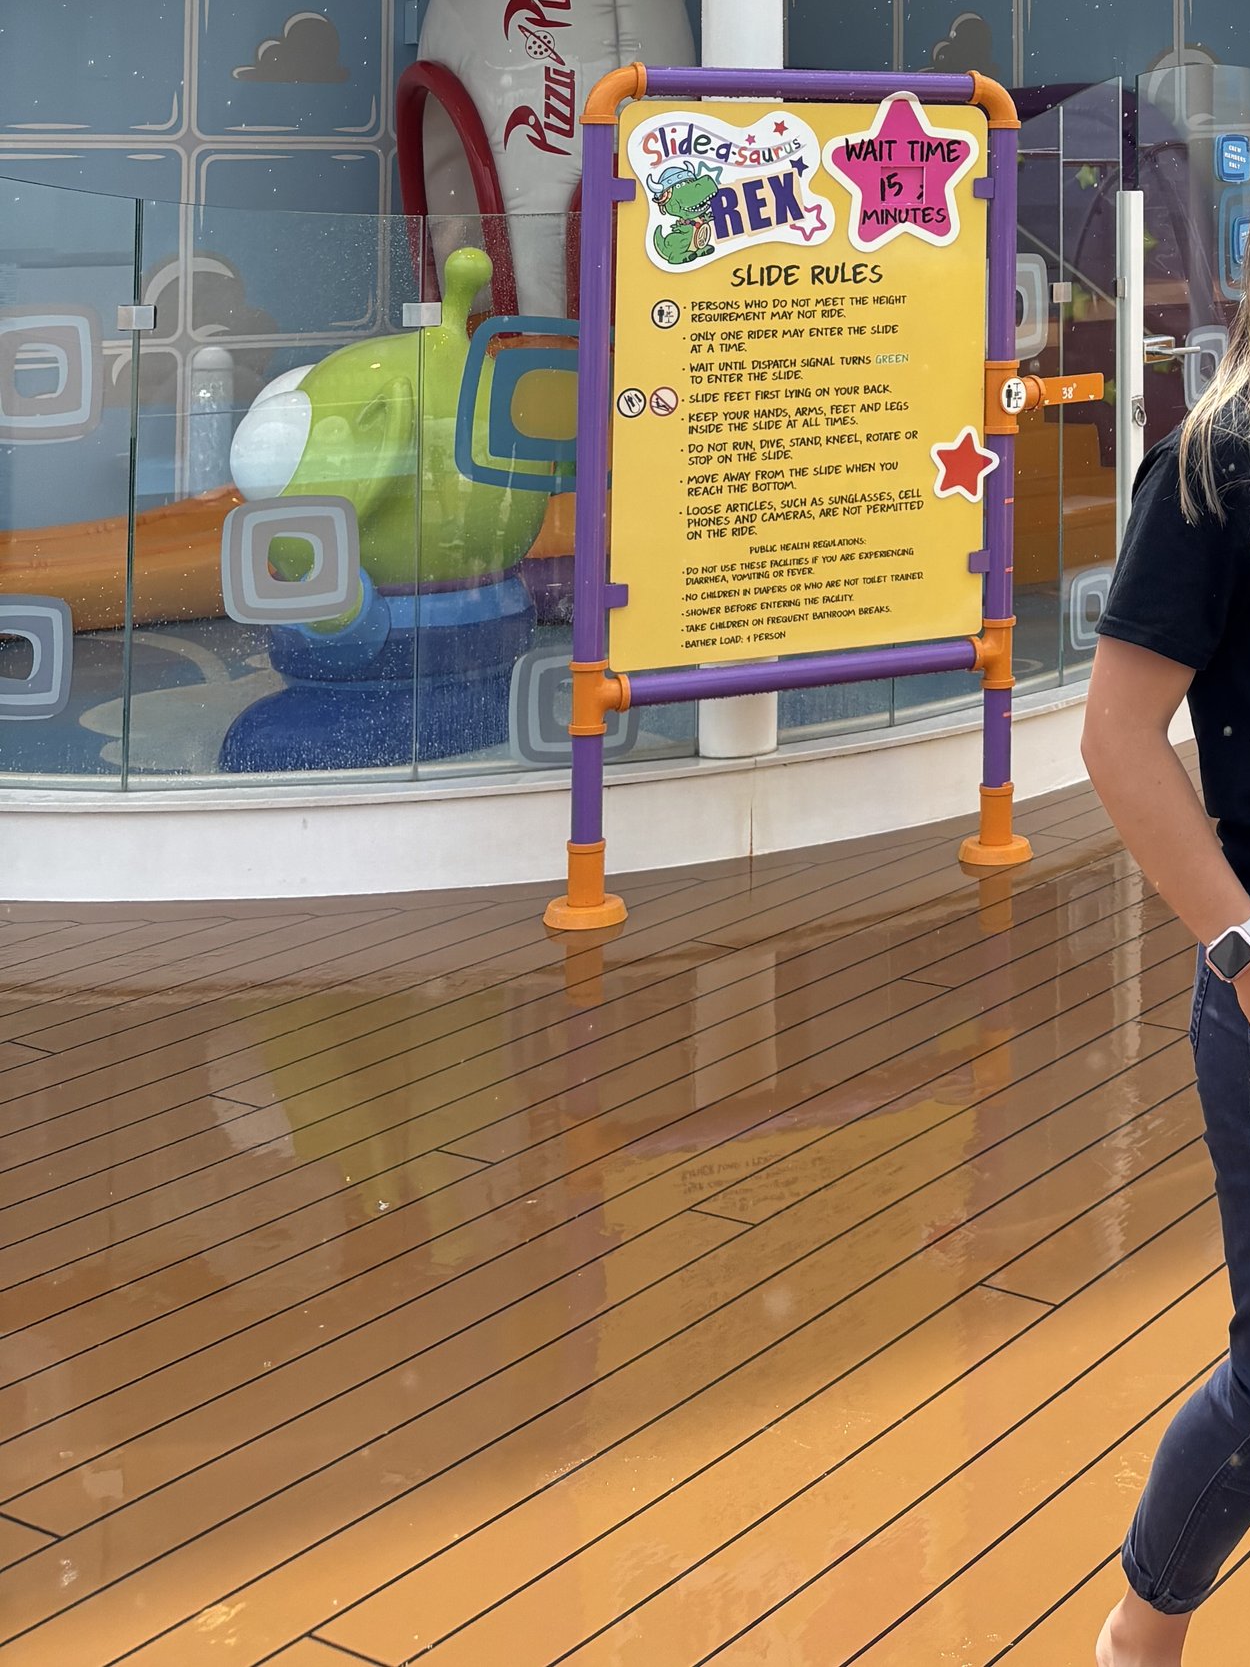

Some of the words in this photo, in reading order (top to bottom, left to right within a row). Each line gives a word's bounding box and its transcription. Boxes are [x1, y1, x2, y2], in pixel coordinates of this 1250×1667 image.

[504, 66, 575, 155] Pizza
[845, 138, 893, 163] WAIT
[909, 139, 961, 163] TIME
[880, 172, 903, 202] 15
[710, 171, 804, 240] REX
[862, 206, 946, 225] MINUTES
[731, 264, 799, 287] SLIDE
[811, 263, 883, 284] RULES
[691, 300, 740, 311] PERSONS
[745, 300, 768, 310] WHO
[772, 299, 788, 308] DO
[792, 298, 811, 308] NOT
[815, 297, 845, 307] MEET
[850, 296, 869, 306] THE
[873, 295, 907, 305] HEIGHT
[691, 310, 767, 323] REQUIREMENT
[770, 311, 794, 320] MAY
[798, 310, 817, 319] NOT
[821, 309, 846, 318] RIDE.
[690, 331, 716, 342] ONLY
[721, 330, 743, 340] ONE
[748, 330, 778, 340] RIDER
[782, 329, 805, 338] MAY
[809, 327, 843, 337] ENTER
[848, 326, 867, 335] THE
[871, 325, 899, 335] SLIDE
[690, 344, 703, 354] AT
[707, 344, 715, 353] A
[720, 342, 747, 352] TIME.
[690, 362, 715, 373] WAIT
[719, 360, 747, 372] UNTIL
[752, 359, 797, 372] DISPATCH
[800, 356, 835, 368] SIGNAL
[840, 356, 872, 366] TURNS
[876, 354, 909, 364] GREEN
[690, 372, 703, 384] TO
[707, 373, 743, 384] ENTER
[748, 372, 768, 381] THE
[772, 370, 803, 381] SLIDE.
[689, 393, 720, 404] SLIDE
[724, 392, 751, 402] FEET
[755, 390, 781, 401] FIRST
[785, 388, 811, 399] LYING
[816, 387, 830, 397] ON
[834, 386, 860, 396] YOUR
[864, 384, 892, 394] BACK.
[689, 412, 718, 423] KEEP
[723, 410, 750, 421] YOUR
[754, 408, 791, 419] HANDS,
[795, 407, 826, 418] ARMS,
[830, 404, 856, 415] FEET
[860, 402, 881, 413] AND
[885, 402, 909, 411] LEGS
[689, 421, 723, 435] INSIDE
[728, 422, 748, 432] THE
[753, 420, 782, 431] SLIDE
[786, 418, 798, 429] AT
[802, 417, 820, 428] ALL
[825, 416, 858, 426] TIMES.
[688, 444, 704, 454] DO
[708, 442, 728, 453] NOT
[732, 440, 756, 451] RUN,
[760, 438, 785, 449] DIVE,
[790, 436, 822, 447] STAND,
[826, 433, 862, 445] KNEEL,
[866, 431, 901, 442] ROTATE
[905, 430, 918, 440] OR
[688, 455, 713, 466] STOP
[717, 454, 732, 464] ON
[737, 452, 757, 462] THE
[762, 450, 793, 461] SLIDE.
[688, 474, 719, 485] MOVE
[723, 472, 751, 482] AWAY
[755, 470, 785, 481] FROM
[789, 467, 809, 477] THE
[813, 465, 842, 476] SLIDE
[846, 462, 876, 474] WHEN
[880, 462, 898, 471] YOU
[688, 484, 723, 497] REACH
[728, 484, 748, 494] THE
[752, 481, 797, 492] BOTTOM.
[687, 504, 722, 516] LOOSE
[726, 501, 776, 513] ARTICLES,
[781, 498, 807, 509] SUCH
[810, 497, 824, 507] AS
[828, 492, 895, 505] SUNGLASSES,
[898, 489, 922, 502] CELL
[688, 516, 730, 528] PHONES
[734, 514, 757, 525] AND
[761, 510, 815, 522] CAMERAS,
[819, 507, 839, 518] ARE
[843, 506, 862, 516] NOT
[866, 500, 924, 514] PERMITTED
[687, 530, 702, 540] ON
[707, 528, 727, 539] THE
[732, 526, 757, 537] RIDE.
[750, 545, 777, 554] PUBLIC
[780, 542, 810, 551] HEALTH
[686, 567, 699, 575] DO
[702, 566, 717, 574] NOT
[721, 564, 737, 572] USE
[740, 561, 767, 570] THESE
[770, 558, 809, 568] FACILITIES
[812, 556, 819, 564] IF
[822, 555, 837, 563] YOU
[840, 553, 856, 562] ARE
[732, 571, 770, 581] VOMITING
[773, 570, 784, 578] OR
[685, 594, 698, 602] NO
[701, 589, 740, 600] CHILDREN
[743, 588, 751, 596] IN
[754, 586, 787, 595] DIAPERS
[790, 584, 801, 592] OR
[804, 582, 823, 590] WHO
[826, 580, 841, 588] ARE
[844, 578, 859, 587] NOT
[863, 576, 887, 584] TOILET
[686, 606, 721, 617] SHOWER
[724, 603, 757, 613] BEFORE
[760, 599, 801, 610] ENTERING
[804, 597, 819, 605] THE
[685, 623, 707, 632] TAKE
[710, 620, 749, 630] CHILDREN
[752, 618, 764, 626] ON
[767, 613, 809, 625] FREQUENT
[812, 609, 856, 620] BATHROOM
[684, 638, 717, 649] BATHER
[754, 631, 786, 642] PERSON
